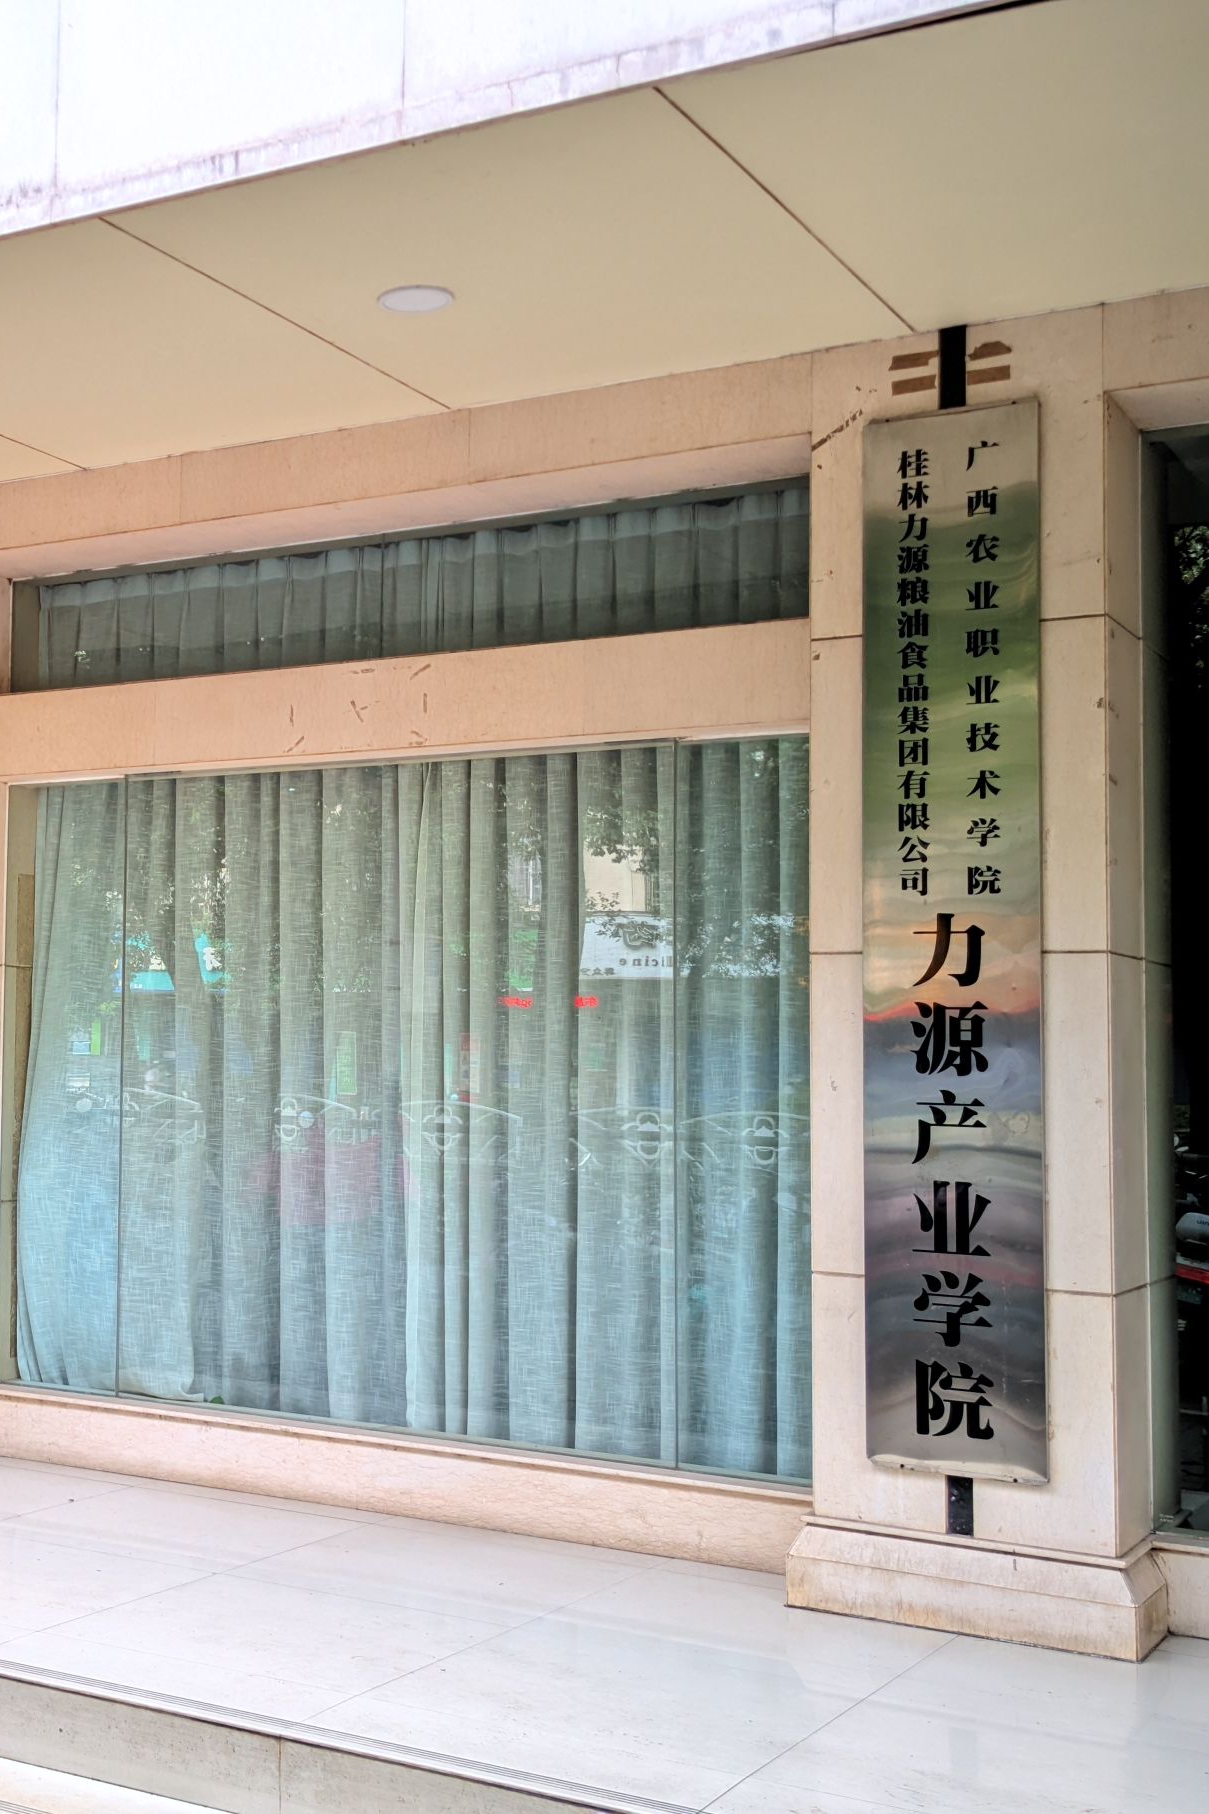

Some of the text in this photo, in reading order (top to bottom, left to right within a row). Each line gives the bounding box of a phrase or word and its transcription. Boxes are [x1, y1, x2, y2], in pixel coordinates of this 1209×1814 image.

[895, 449, 930, 898] 桂林力源粮油食品集团有限公司
[965, 440, 1001, 896] 广西农业职业技术学院
[909, 912, 995, 1441] 力源产业学院
